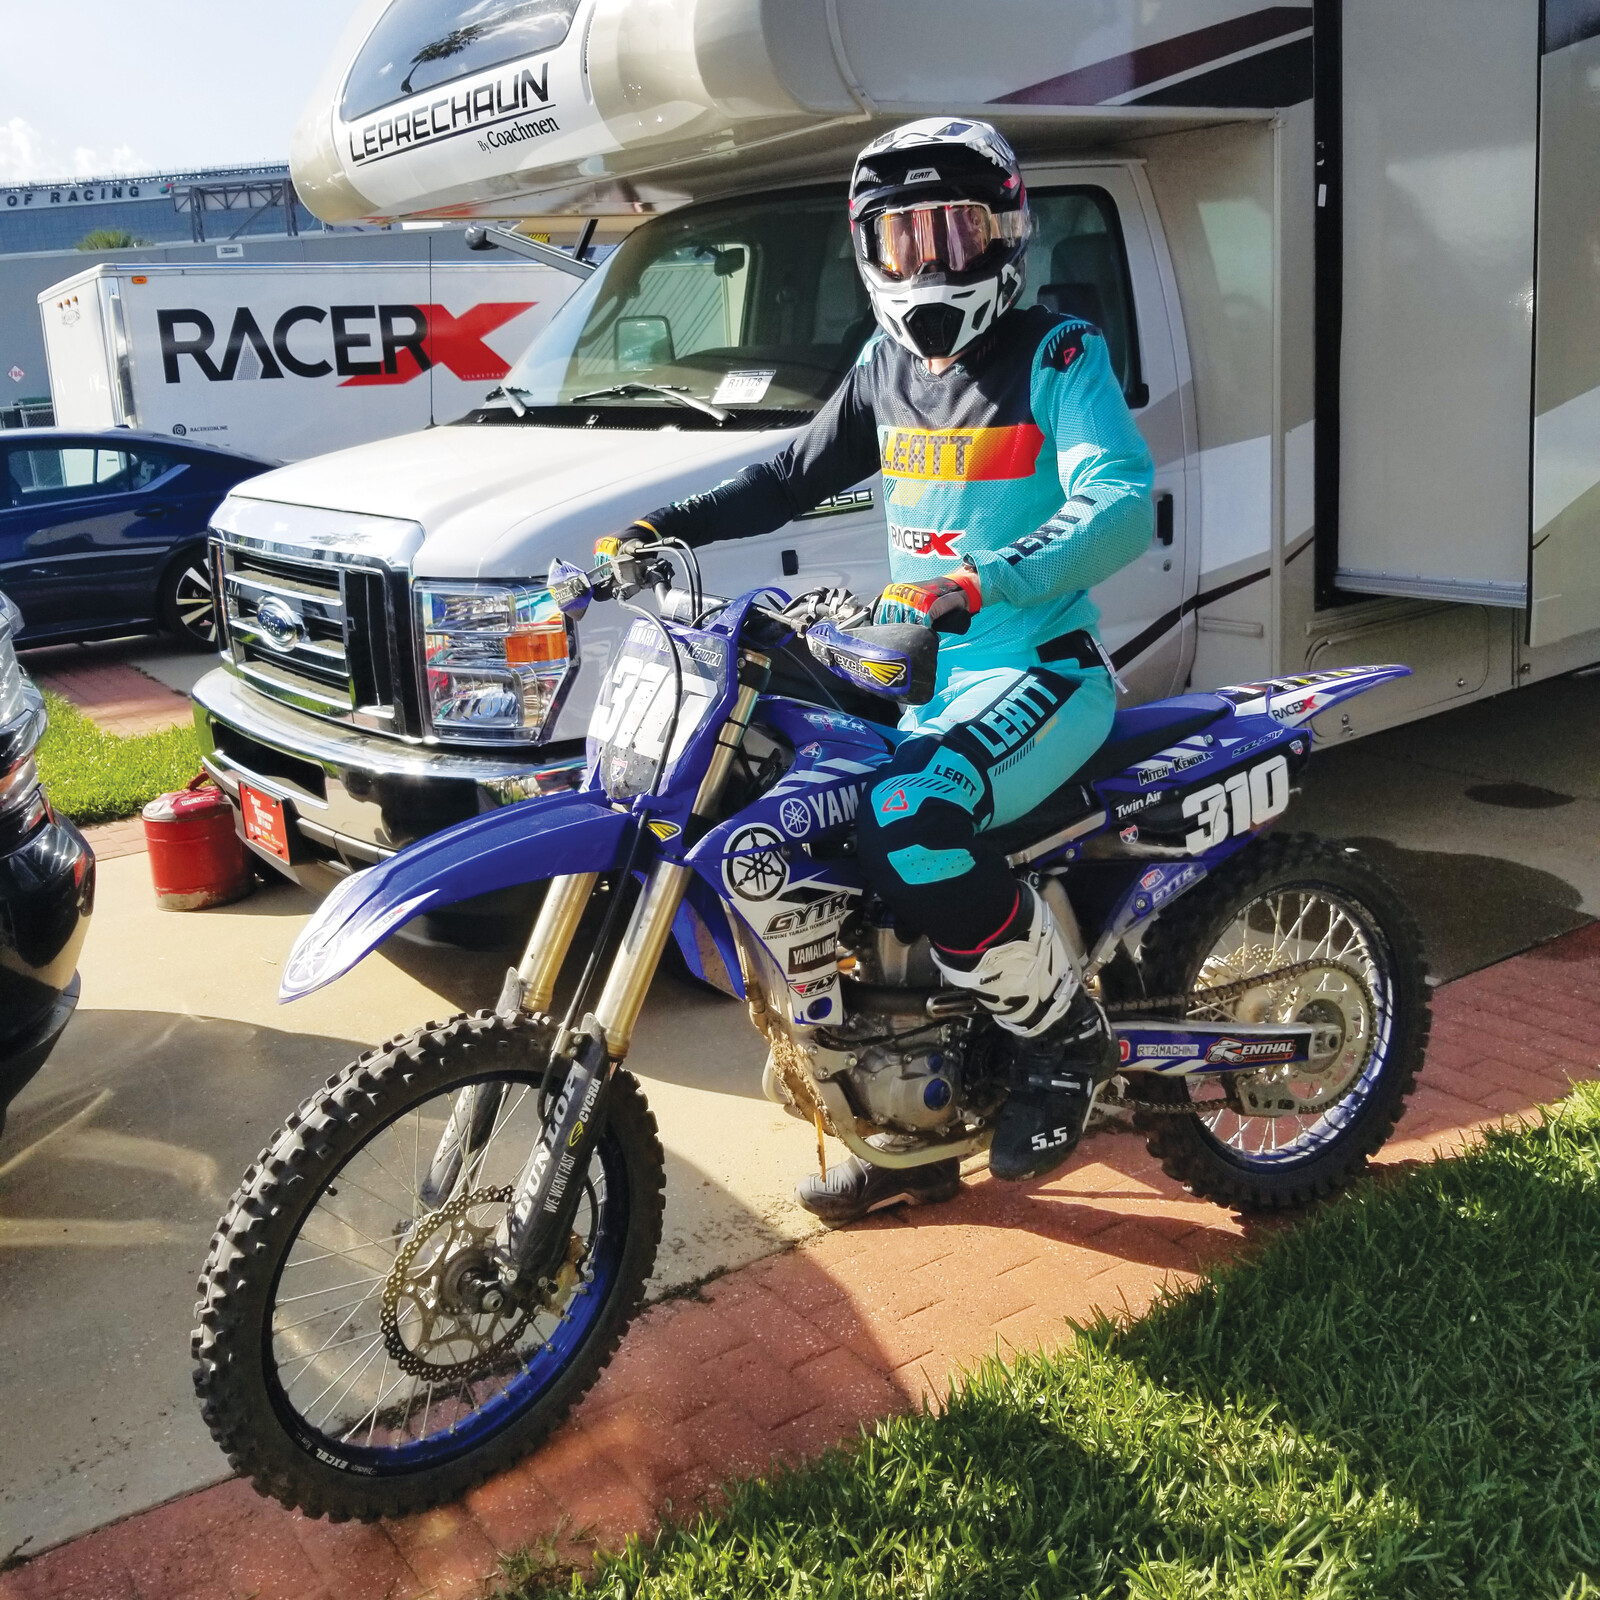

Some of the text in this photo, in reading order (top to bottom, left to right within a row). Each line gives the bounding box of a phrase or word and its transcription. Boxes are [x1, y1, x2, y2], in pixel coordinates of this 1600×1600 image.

[349, 61, 549, 162] LEPRECHAUN
[477, 116, 560, 154] By Coachmen
[909, 171, 932, 181] LEATT
[6, 186, 140, 207] OF RACING
[882, 430, 974, 476] LEATT
[966, 674, 1058, 758] LEATT
[933, 764, 977, 797] LEATT
[807, 781, 868, 829] YAM
[1115, 799, 1144, 818] Twin
[1145, 790, 1162, 806] Air
[1182, 754, 1289, 856] 310
[1152, 867, 1198, 903] GYTR
[764, 890, 848, 935] GYTR
[762, 932, 788, 941] GENUINE
[792, 936, 835, 965] YAMALUBE
[804, 972, 839, 993] FLY
[578, 1078, 602, 1124] CYCRA
[514, 1072, 579, 1226] DUNLOP
[1031, 1127, 1068, 1151] 5.5
[543, 1151, 577, 1214] WE WENT FAST
[315, 1447, 349, 1470] EXCEL
